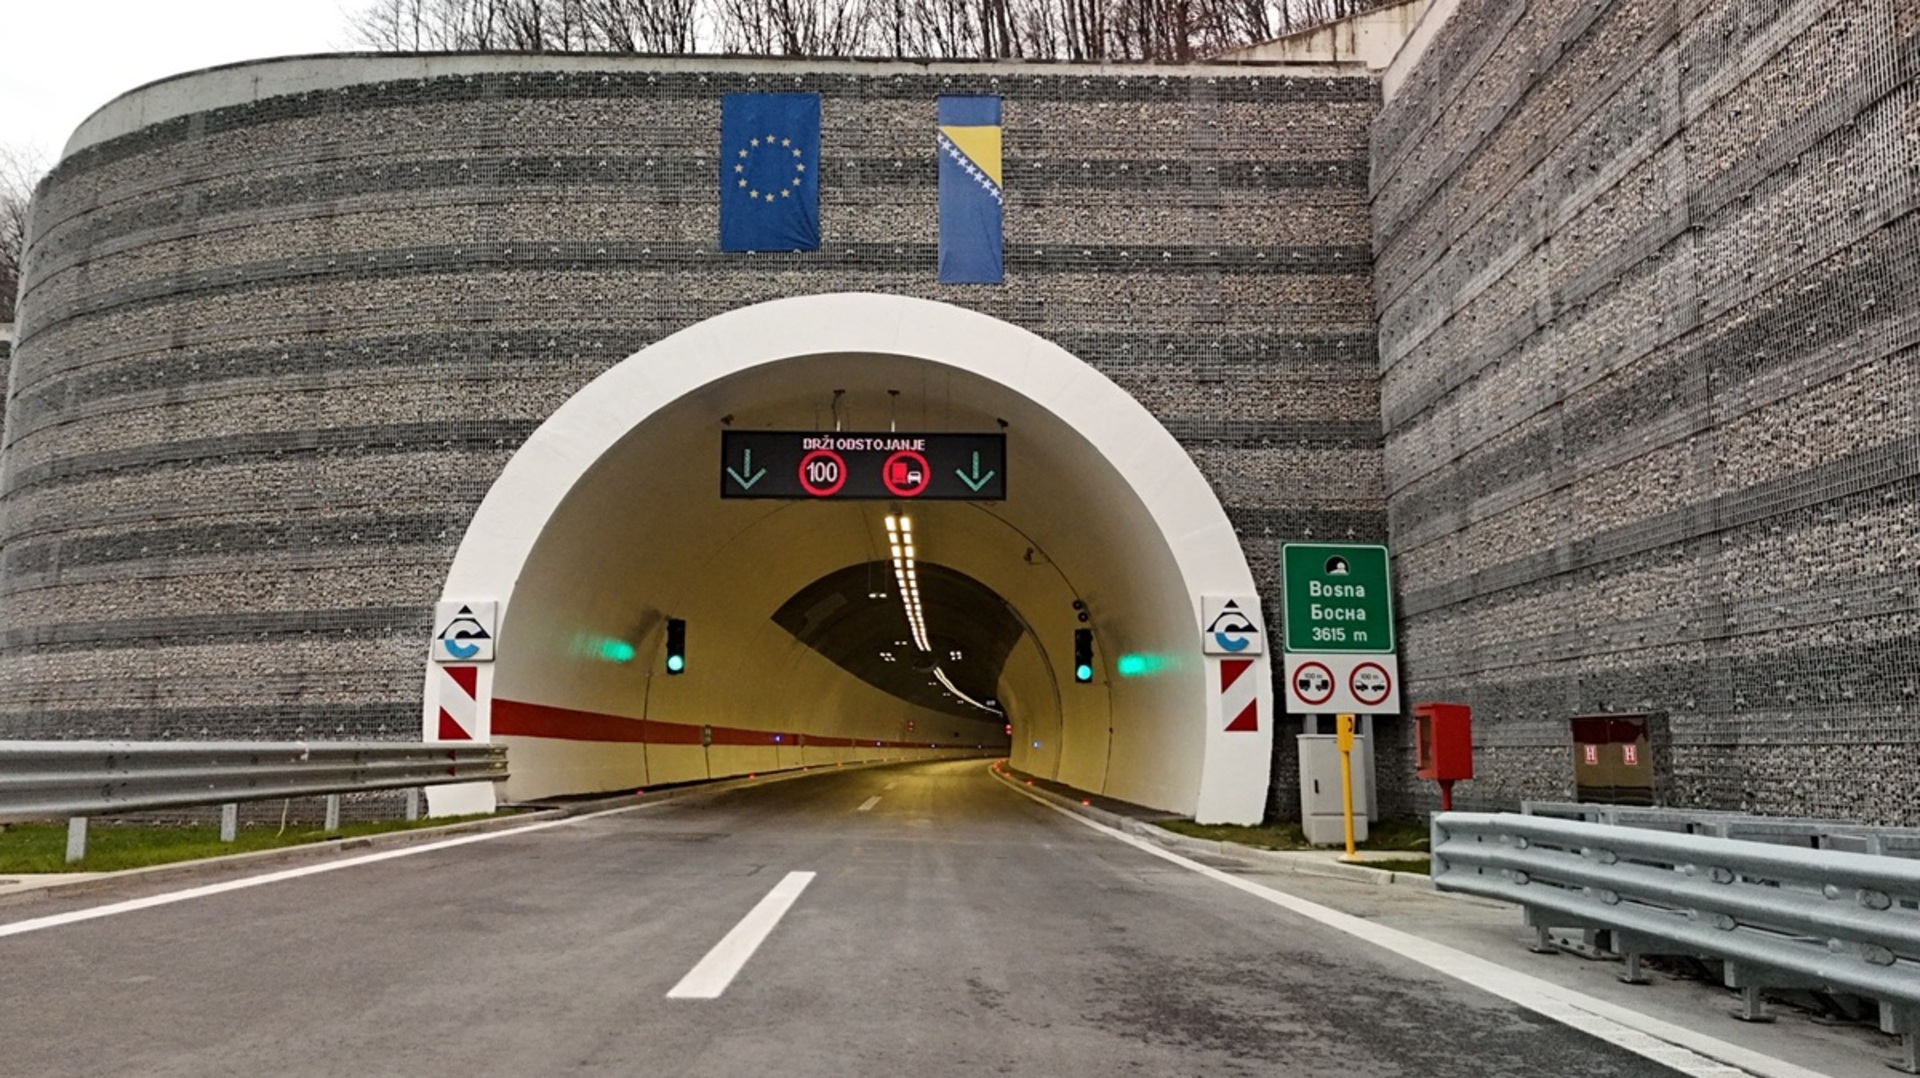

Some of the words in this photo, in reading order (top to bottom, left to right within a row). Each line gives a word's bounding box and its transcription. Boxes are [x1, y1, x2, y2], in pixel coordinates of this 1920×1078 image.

[803, 435, 834, 450] DRŽI
[837, 437, 926, 451] ODSTOJANJE
[806, 462, 838, 483] 100
[1309, 580, 1366, 598] Bosna
[1310, 603, 1367, 621] Босна
[1312, 626, 1347, 642] 3615
[1353, 630, 1368, 642] m
[1585, 746, 1596, 761] H
[1624, 746, 1636, 761] H
